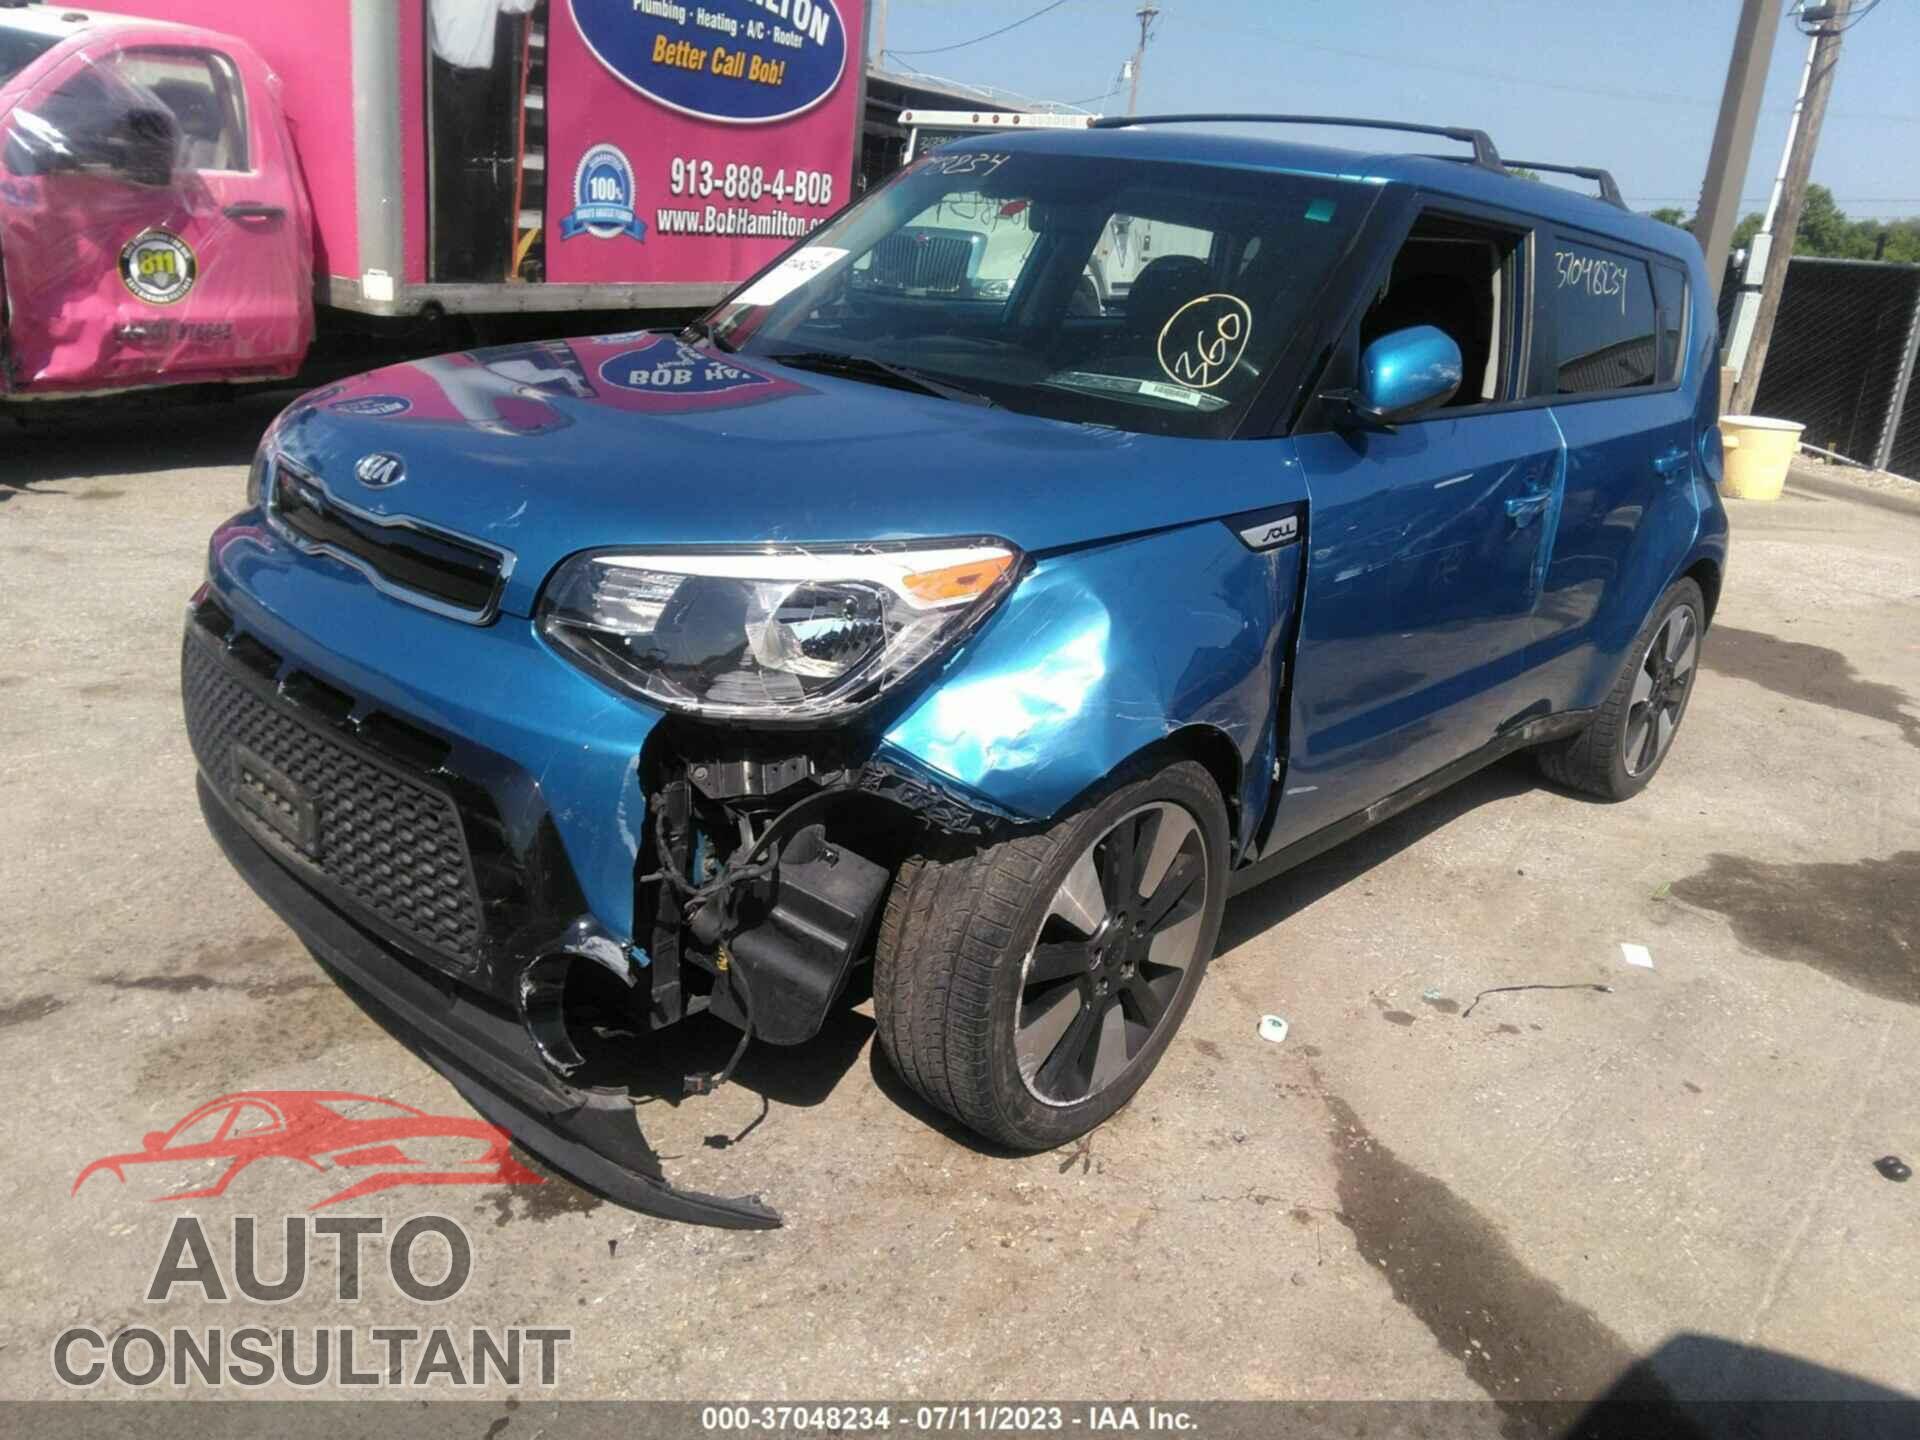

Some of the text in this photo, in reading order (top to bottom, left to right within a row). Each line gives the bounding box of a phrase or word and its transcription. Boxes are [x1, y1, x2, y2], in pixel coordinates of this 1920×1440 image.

[632, 0, 803, 49] Plumbing Heating A/C Rooter
[652, 34, 786, 85] Better Call Bob!
[671, 157, 833, 205] 913-888-4-BOB
[137, 249, 176, 277] 811
